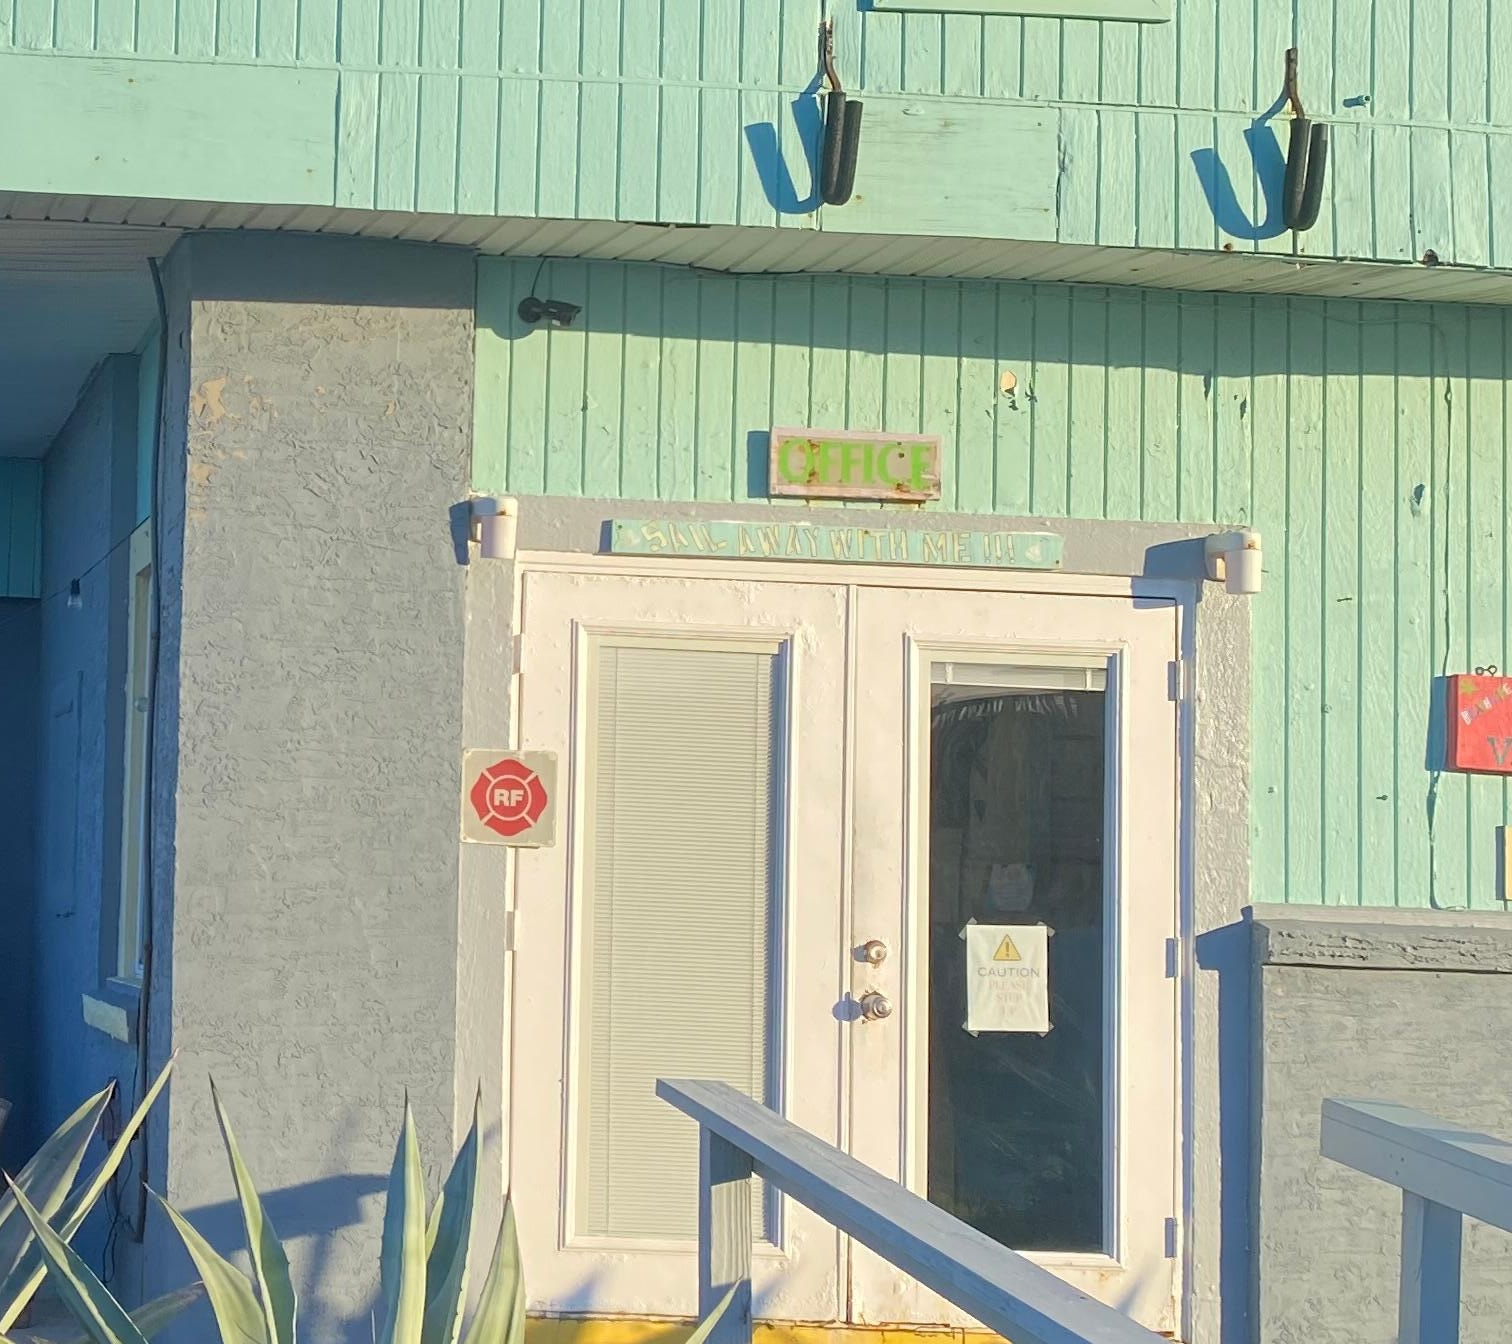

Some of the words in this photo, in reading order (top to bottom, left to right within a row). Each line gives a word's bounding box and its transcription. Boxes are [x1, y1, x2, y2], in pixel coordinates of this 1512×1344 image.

[778, 436, 932, 490] OFFICE
[641, 520, 728, 552] SAIL
[738, 523, 819, 557] AWAY
[829, 528, 909, 560] WITH
[923, 531, 972, 563] ME
[493, 788, 525, 807] RF
[977, 967, 1040, 977] CAUTION
